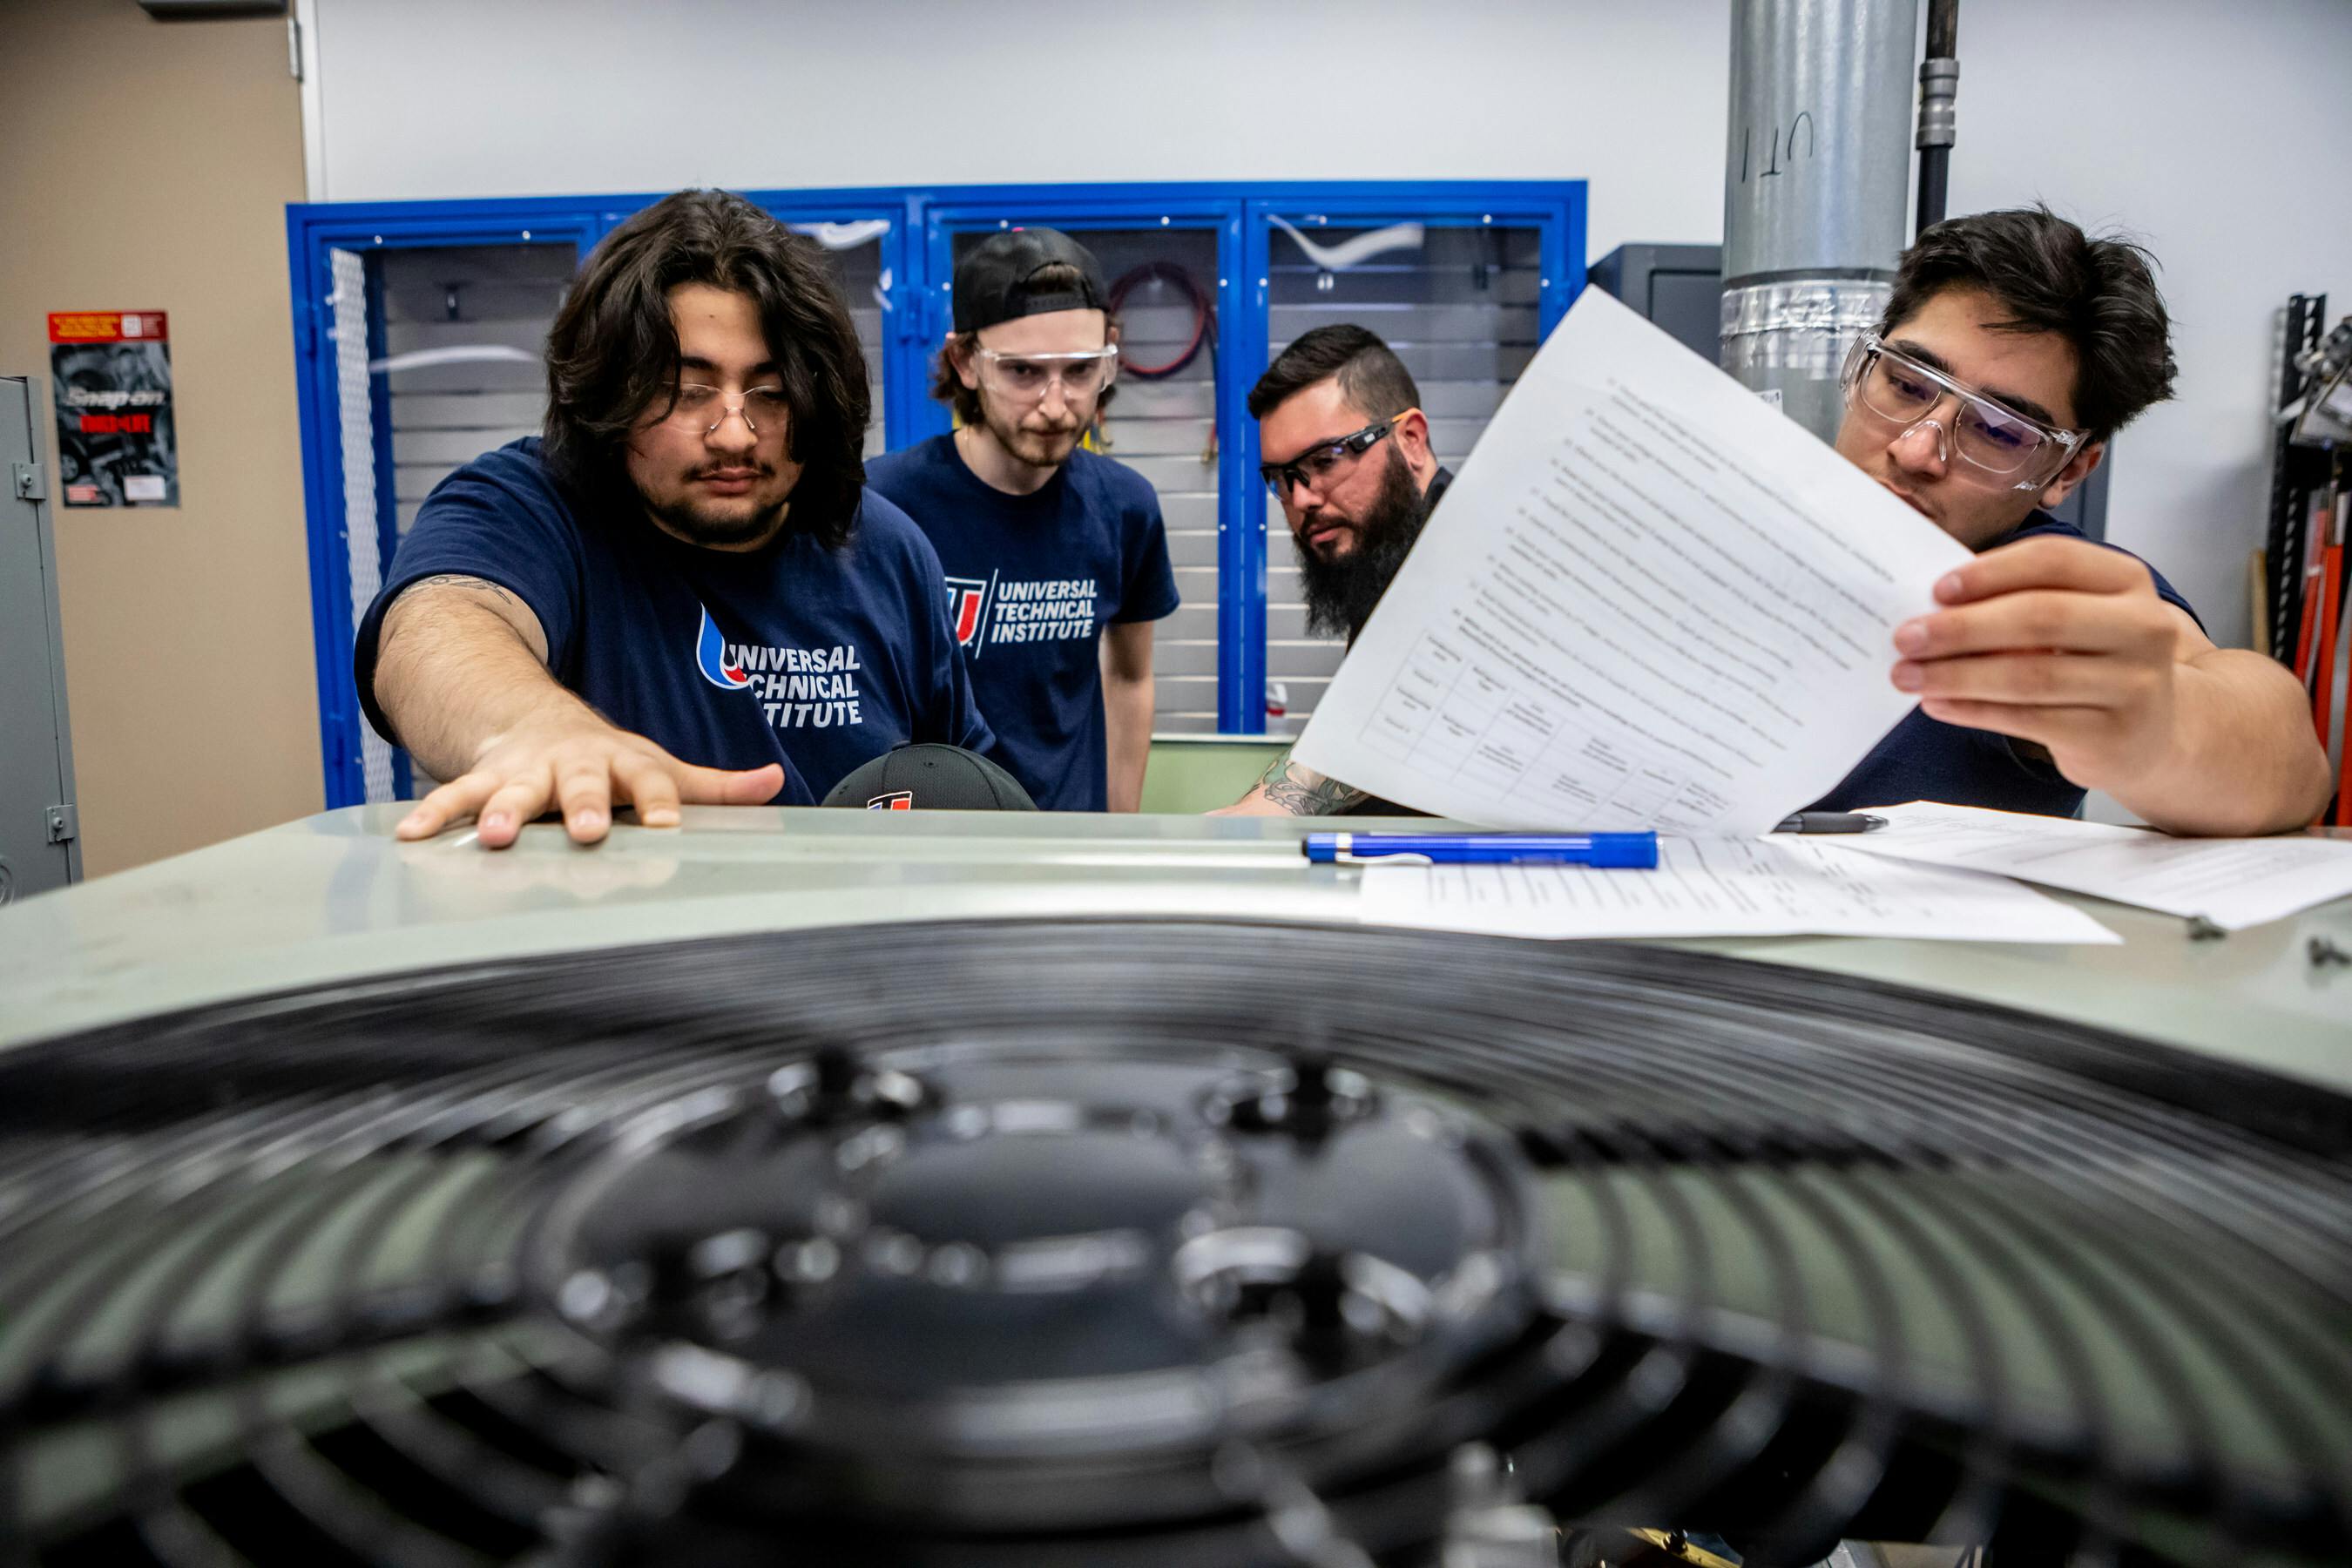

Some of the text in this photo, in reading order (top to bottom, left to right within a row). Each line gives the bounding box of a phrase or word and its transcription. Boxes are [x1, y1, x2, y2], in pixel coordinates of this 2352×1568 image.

[998, 579, 1098, 601] UNIVERSAL
[995, 599, 1095, 622] TECHNICAL
[990, 619, 1094, 643] INSTITUTE
[729, 644, 861, 673] NIVERSAL
[745, 673, 860, 700] CHNICAL
[763, 700, 862, 727] TITUTE
